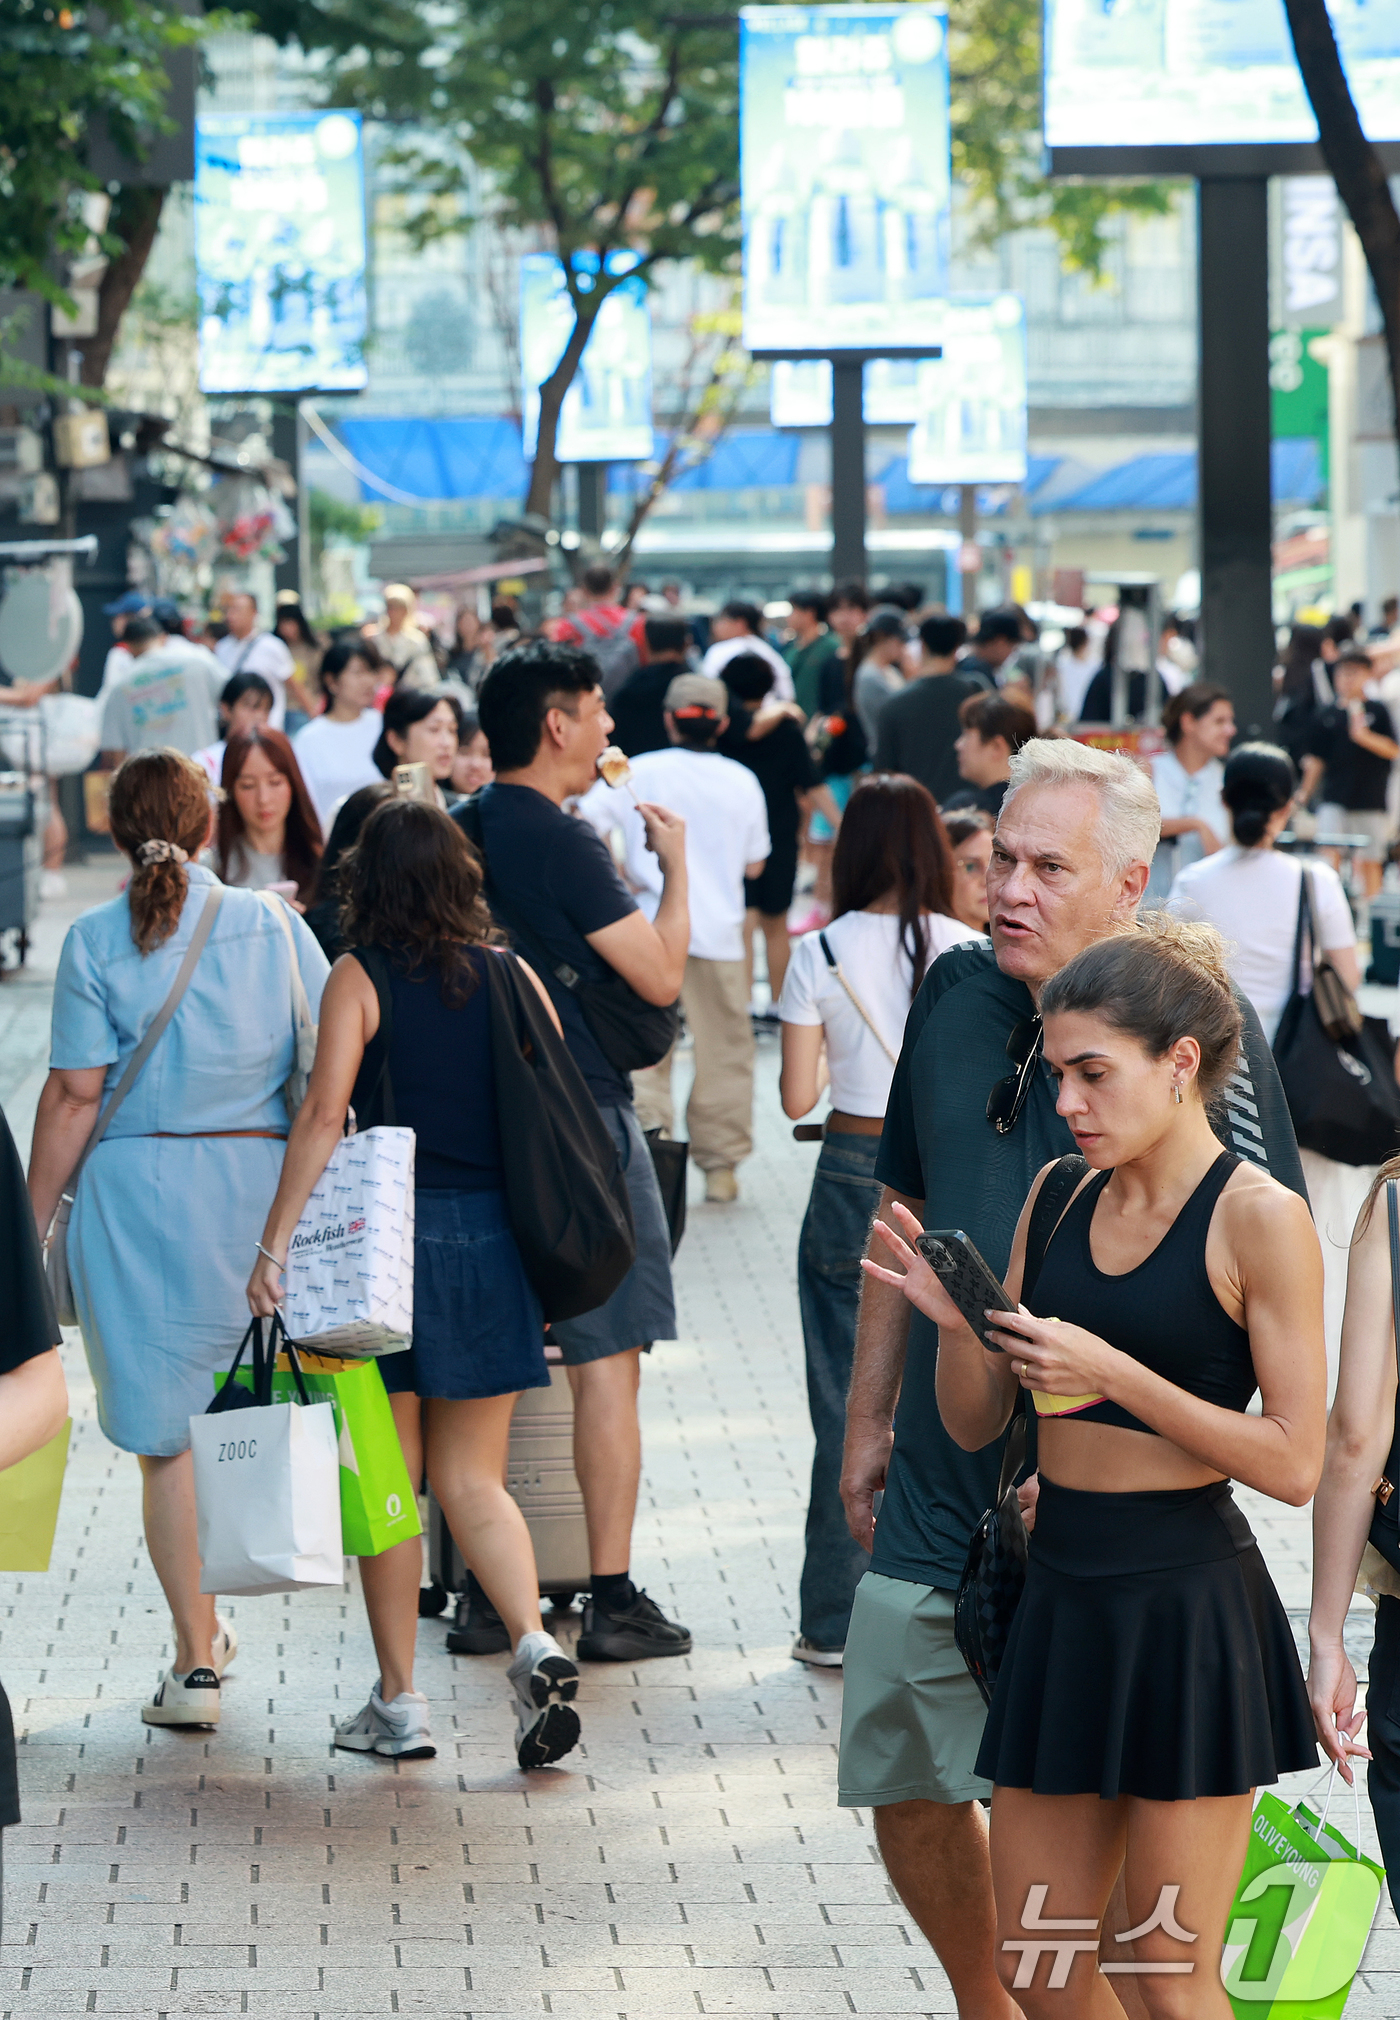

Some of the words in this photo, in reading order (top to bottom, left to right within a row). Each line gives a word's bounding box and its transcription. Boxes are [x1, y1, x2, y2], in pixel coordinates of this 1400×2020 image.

[292, 1224, 344, 1248] Rockfish
[218, 1439, 257, 1462] ZOOC
[192, 1674, 215, 1683] VEJA
